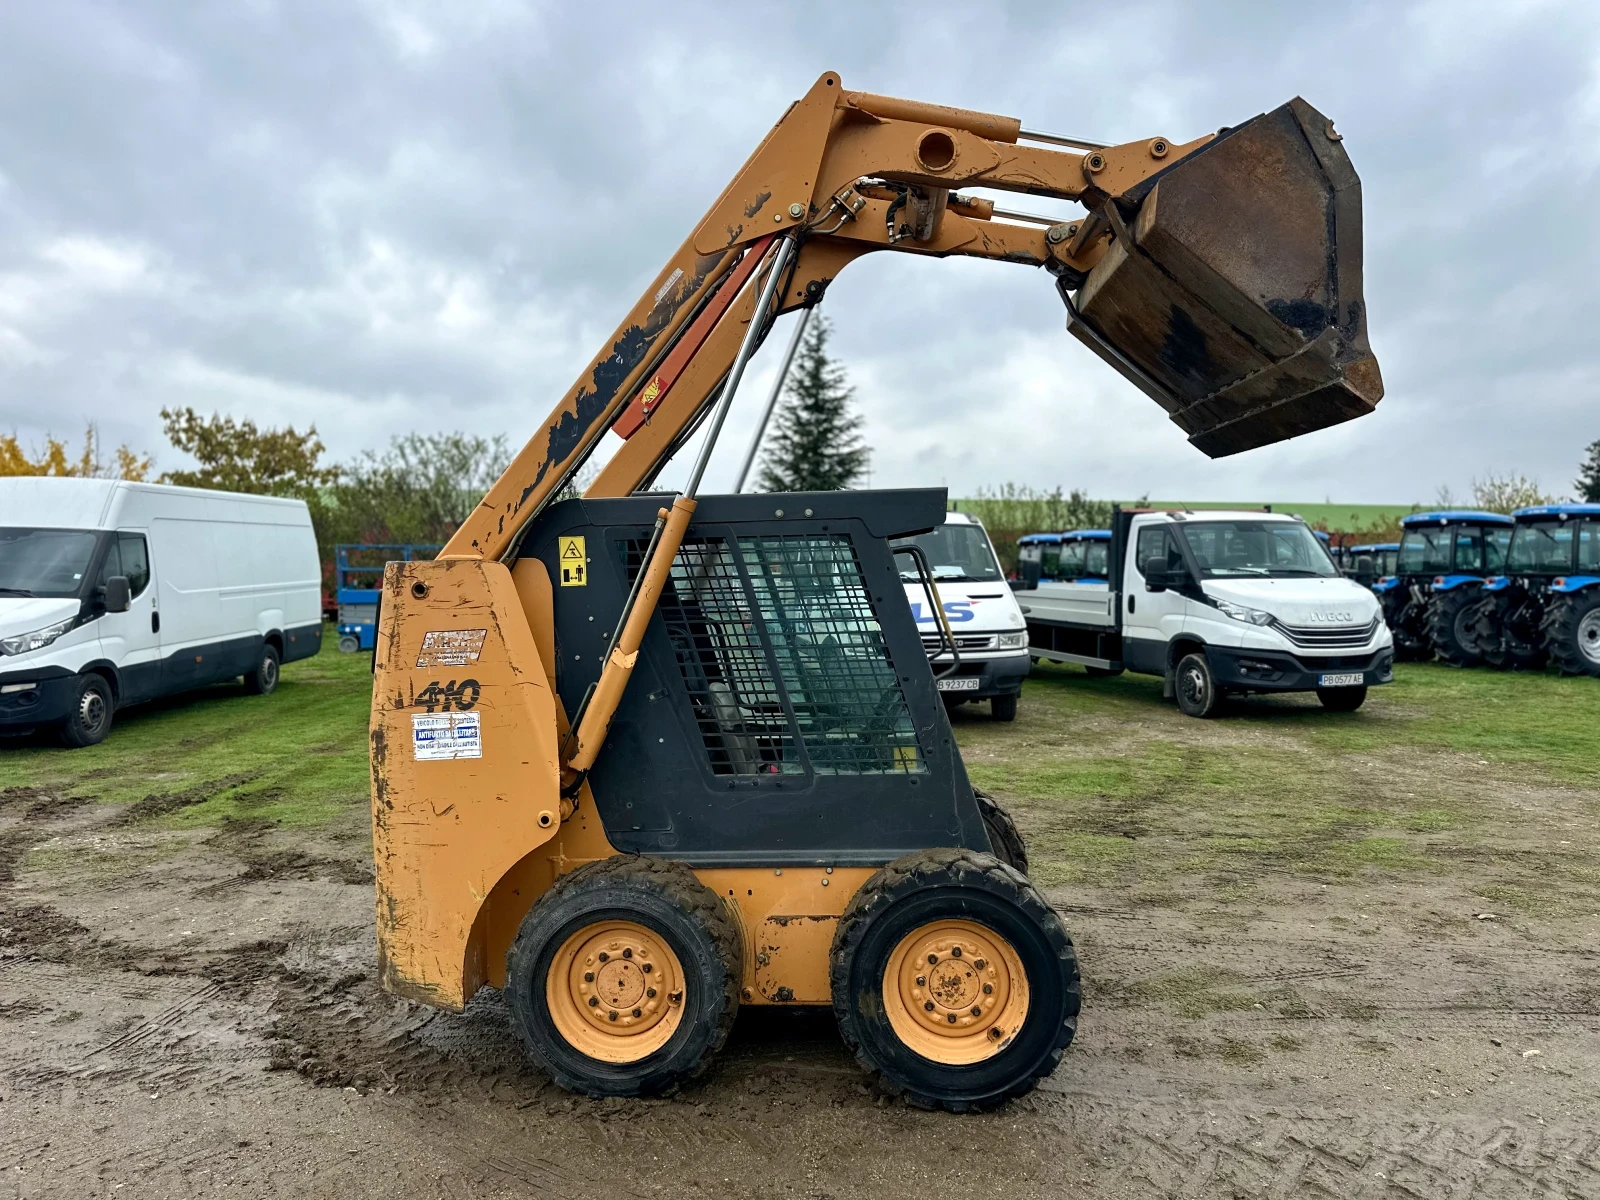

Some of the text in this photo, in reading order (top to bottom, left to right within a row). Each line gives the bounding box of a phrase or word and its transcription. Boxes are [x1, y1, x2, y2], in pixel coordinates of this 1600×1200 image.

[1310, 611, 1353, 621] IVECO
[946, 681, 965, 689] 9237
[967, 680, 978, 688] CB
[1324, 674, 1362, 685] PB 0577 AE
[414, 679, 480, 712] 410
[418, 730, 445, 739] ANTIFURTO
